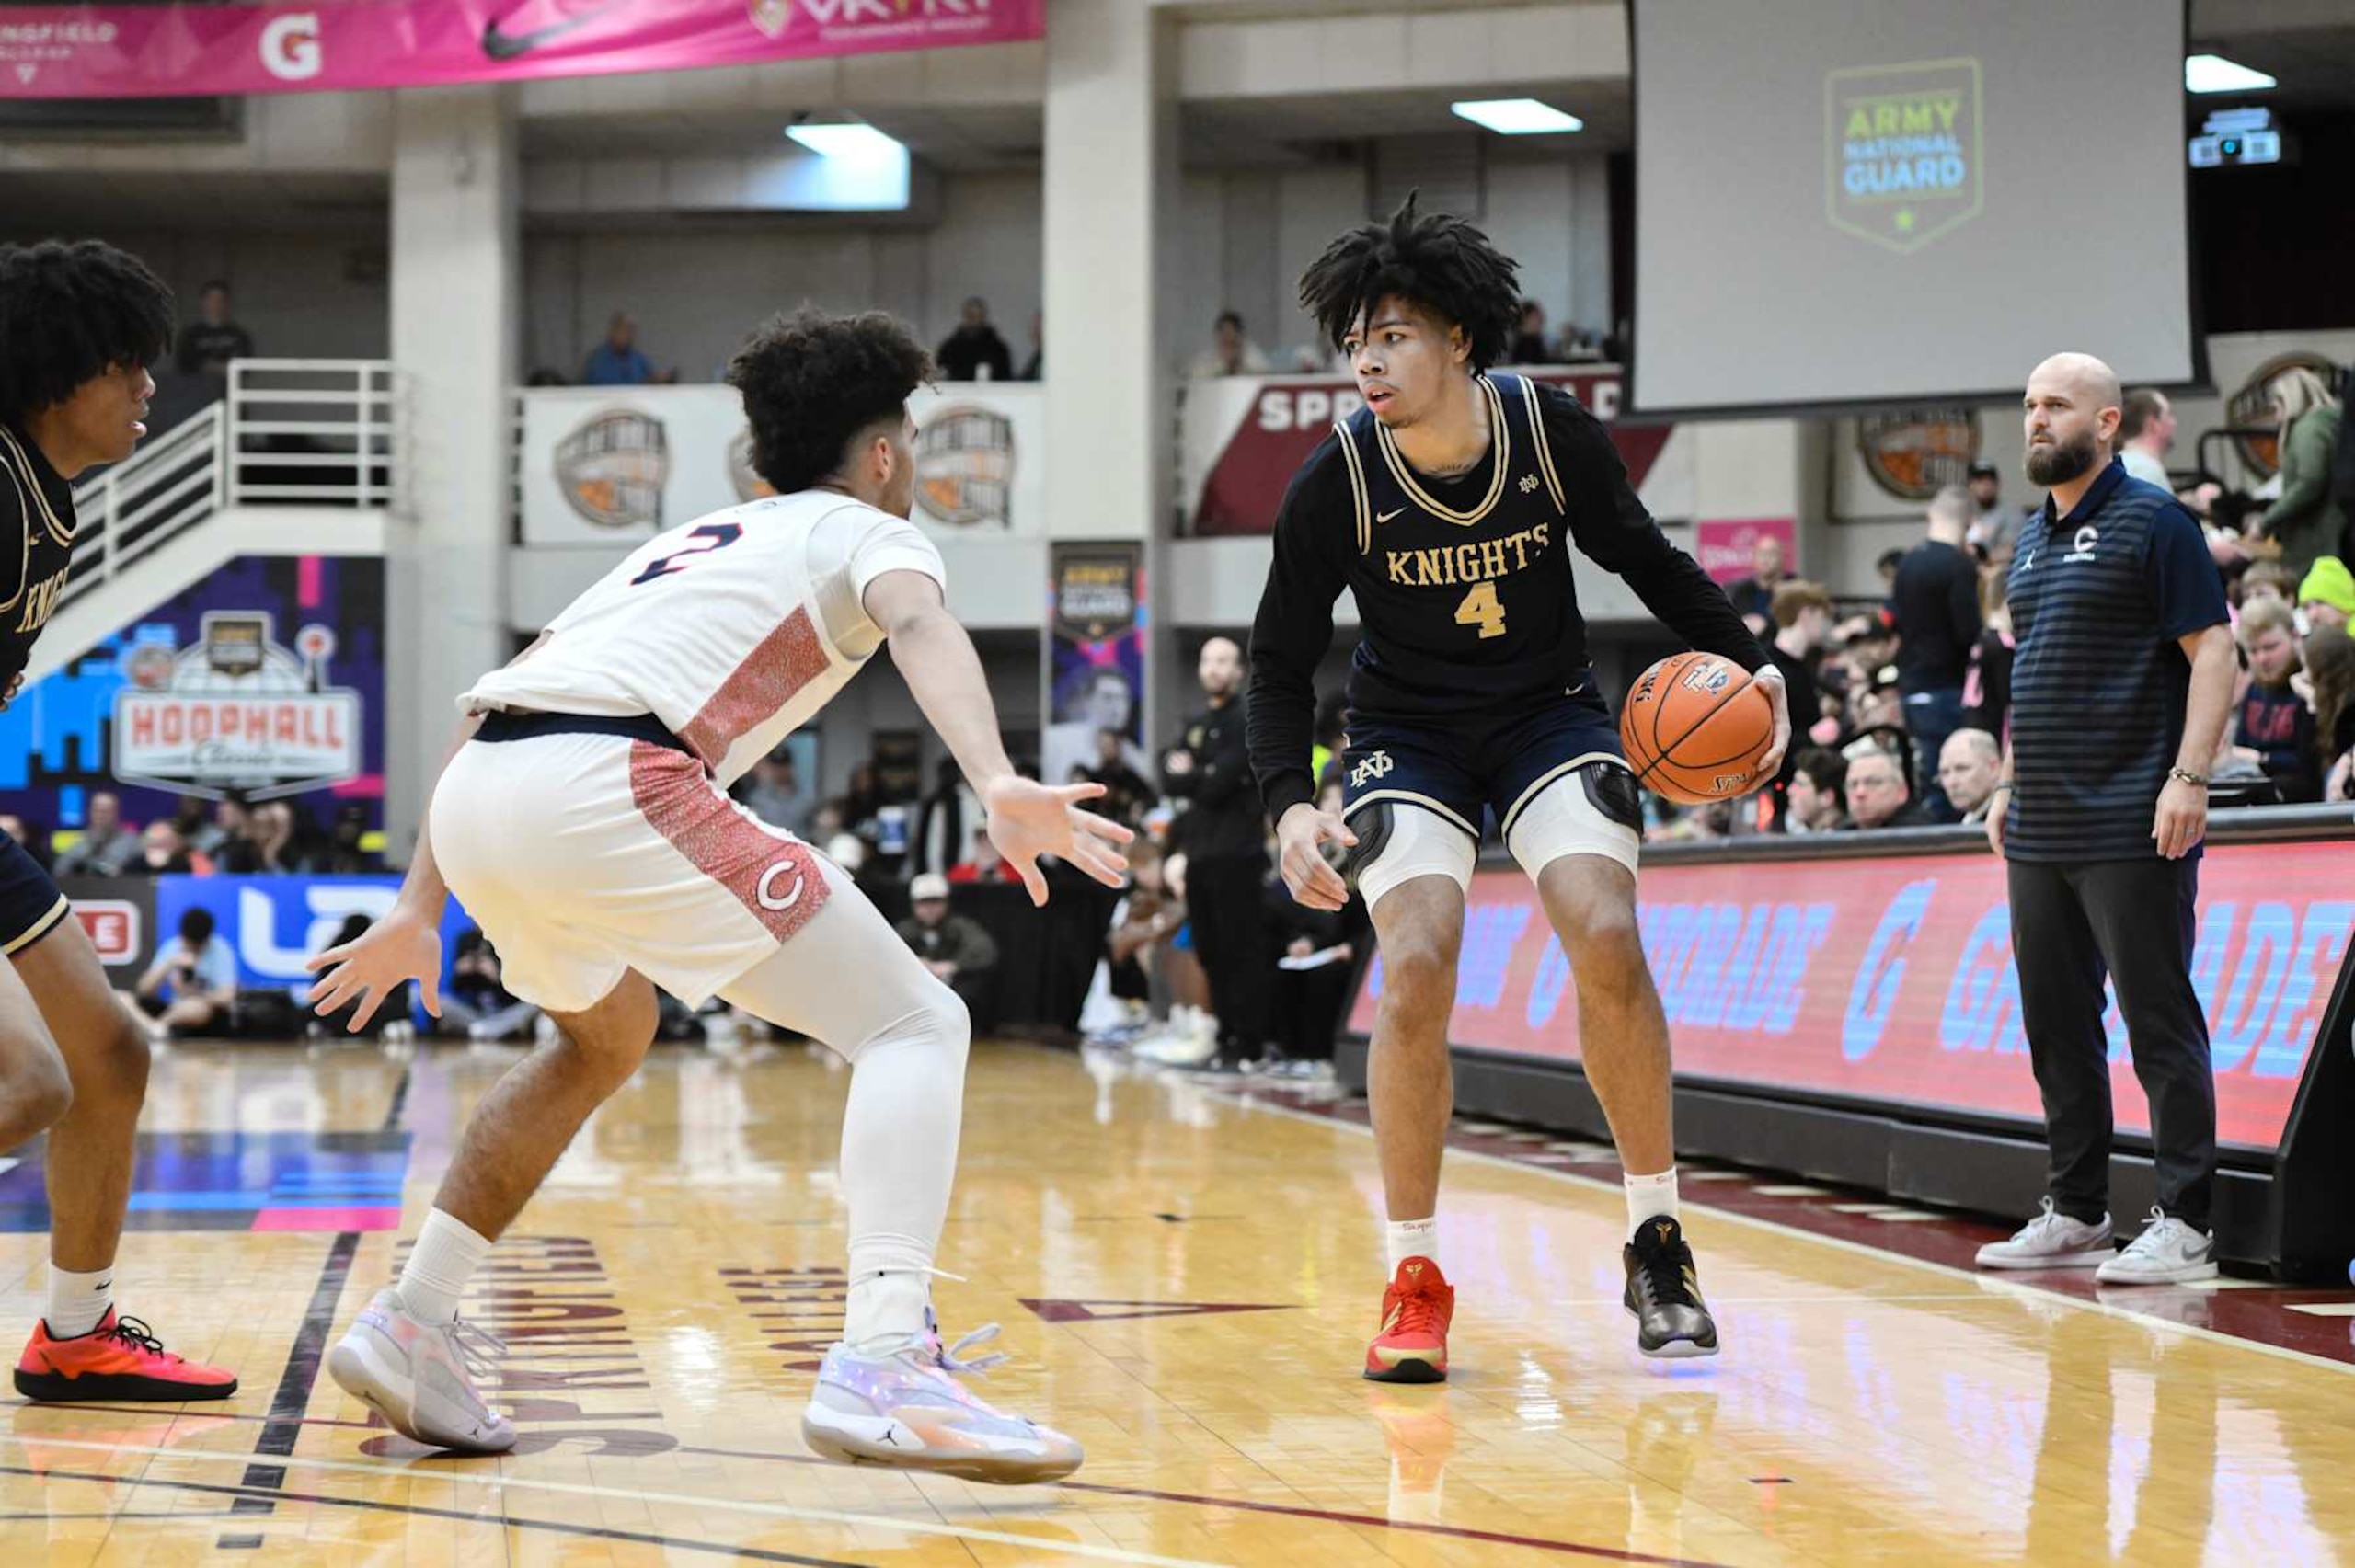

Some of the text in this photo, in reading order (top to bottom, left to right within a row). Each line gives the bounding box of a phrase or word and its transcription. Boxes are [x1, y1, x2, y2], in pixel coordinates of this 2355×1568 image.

[259, 14, 320, 80] G
[1846, 101, 1959, 137] ARMY
[1844, 156, 1965, 196] GUARD
[629, 521, 743, 586] 2
[1386, 521, 1550, 587] KNIGHTS
[2074, 525, 2099, 553] C
[1453, 580, 1507, 639] 4
[132, 703, 343, 750] HOOPHALL
[755, 859, 805, 911] C
[1842, 877, 1937, 1062] G
